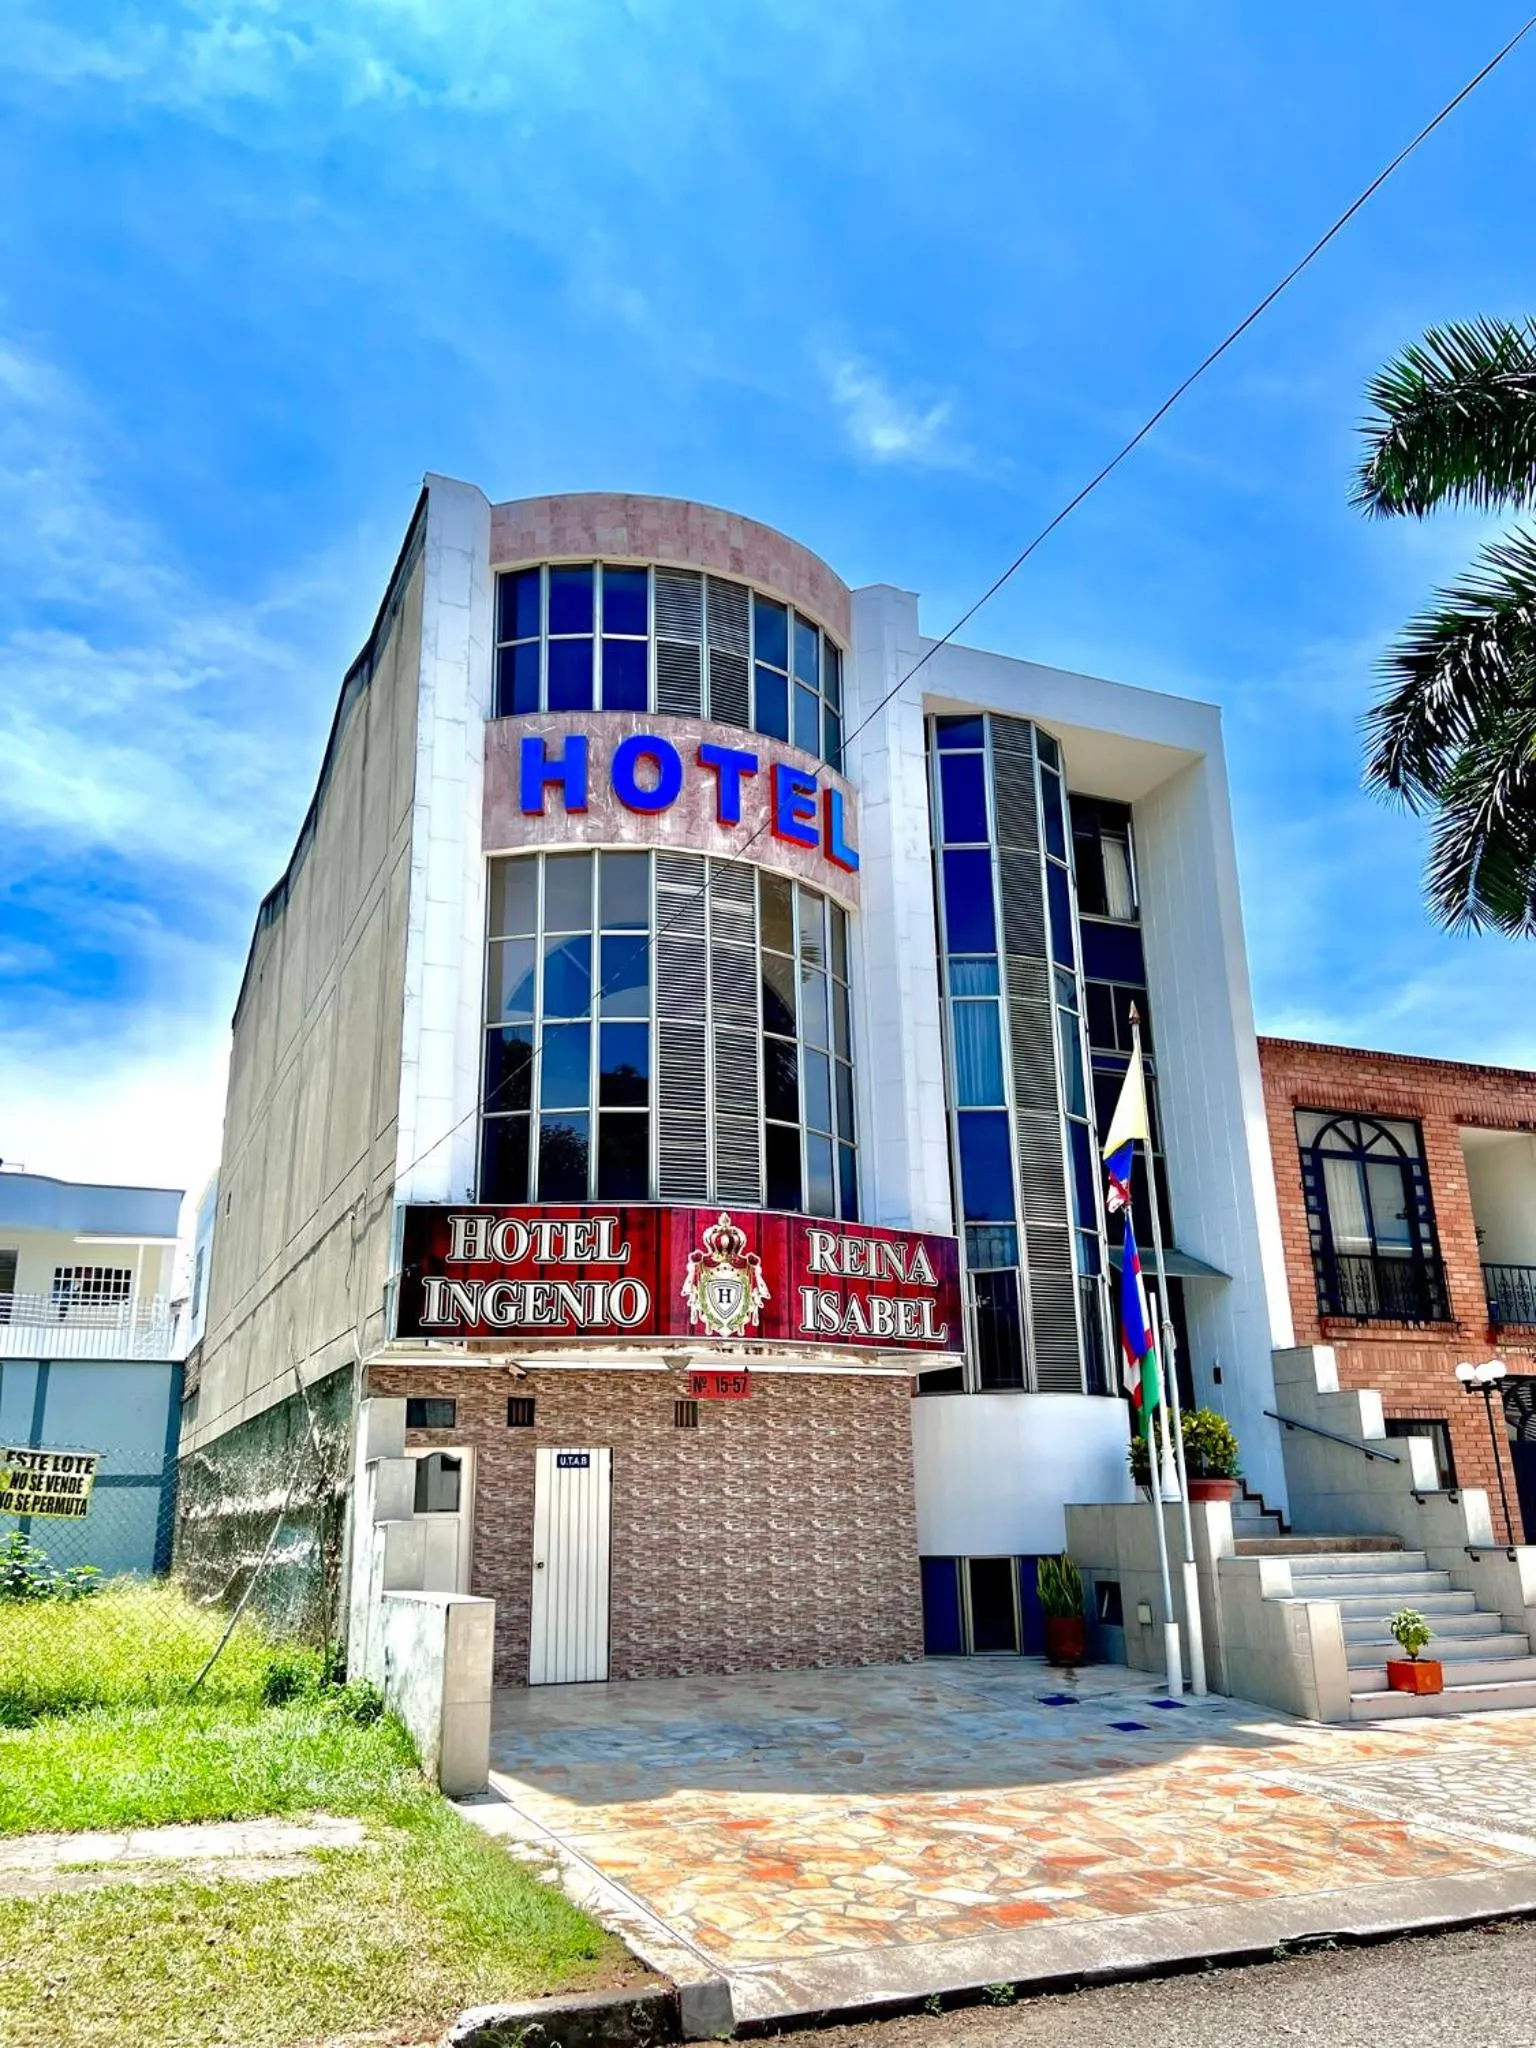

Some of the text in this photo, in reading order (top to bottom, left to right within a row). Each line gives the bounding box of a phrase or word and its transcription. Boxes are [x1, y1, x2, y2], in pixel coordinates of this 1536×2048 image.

[520, 734, 859, 873] HOTEL
[446, 1215, 631, 1264] HOTEL
[806, 1229, 938, 1286] REINA
[419, 1277, 650, 1327] INGENIO
[718, 1288, 732, 1303] H
[799, 1286, 948, 1343] ISABEL
[715, 1375, 748, 1393] 15-57
[6, 1450, 95, 1474] ESTE LOTE
[9, 1471, 83, 1494] NO SE VENDE
[14, 1493, 31, 1512] SE
[31, 1495, 87, 1515] PERMUTA
